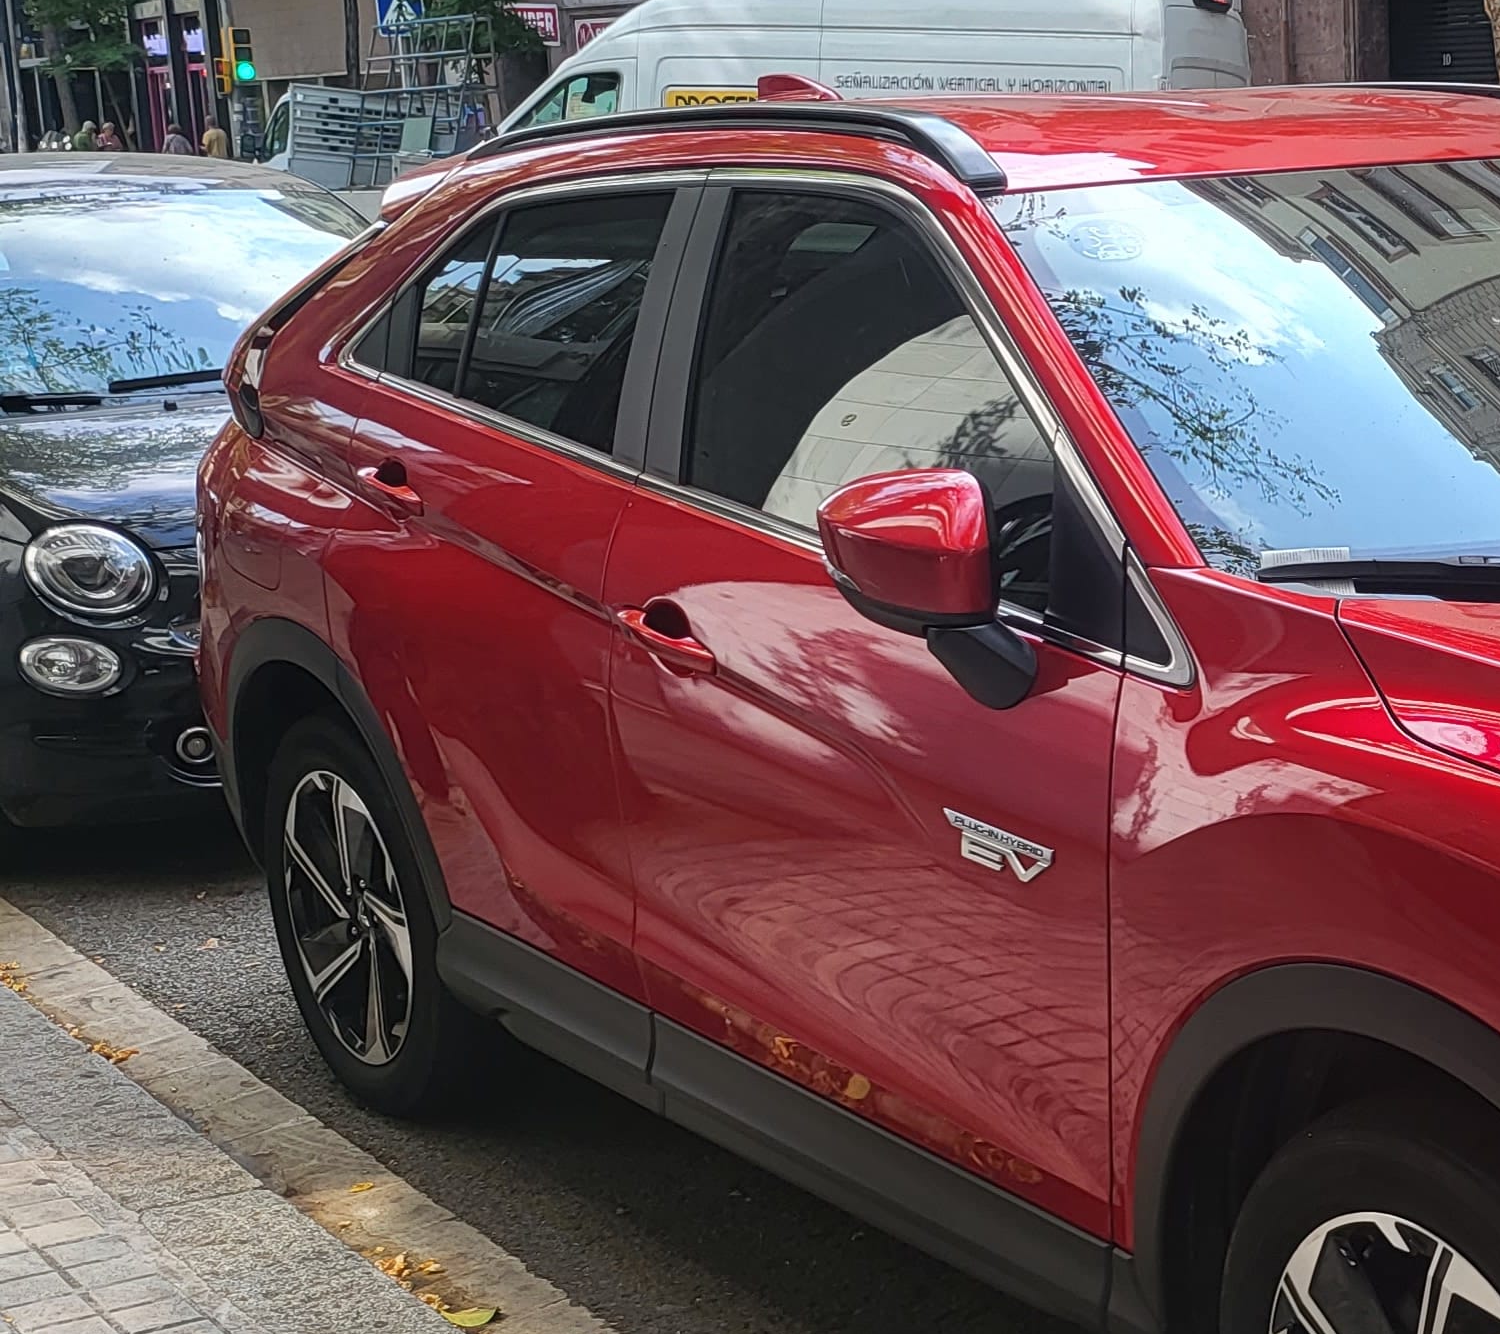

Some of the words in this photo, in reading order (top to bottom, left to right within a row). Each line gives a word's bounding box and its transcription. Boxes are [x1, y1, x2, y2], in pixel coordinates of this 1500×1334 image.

[936, 75, 1002, 92] VERTICAL
[1007, 78, 1016, 92] Y
[953, 815, 1000, 840] PLUG-IN
[999, 835, 1044, 858] HYBRID
[961, 831, 1053, 882] EV
